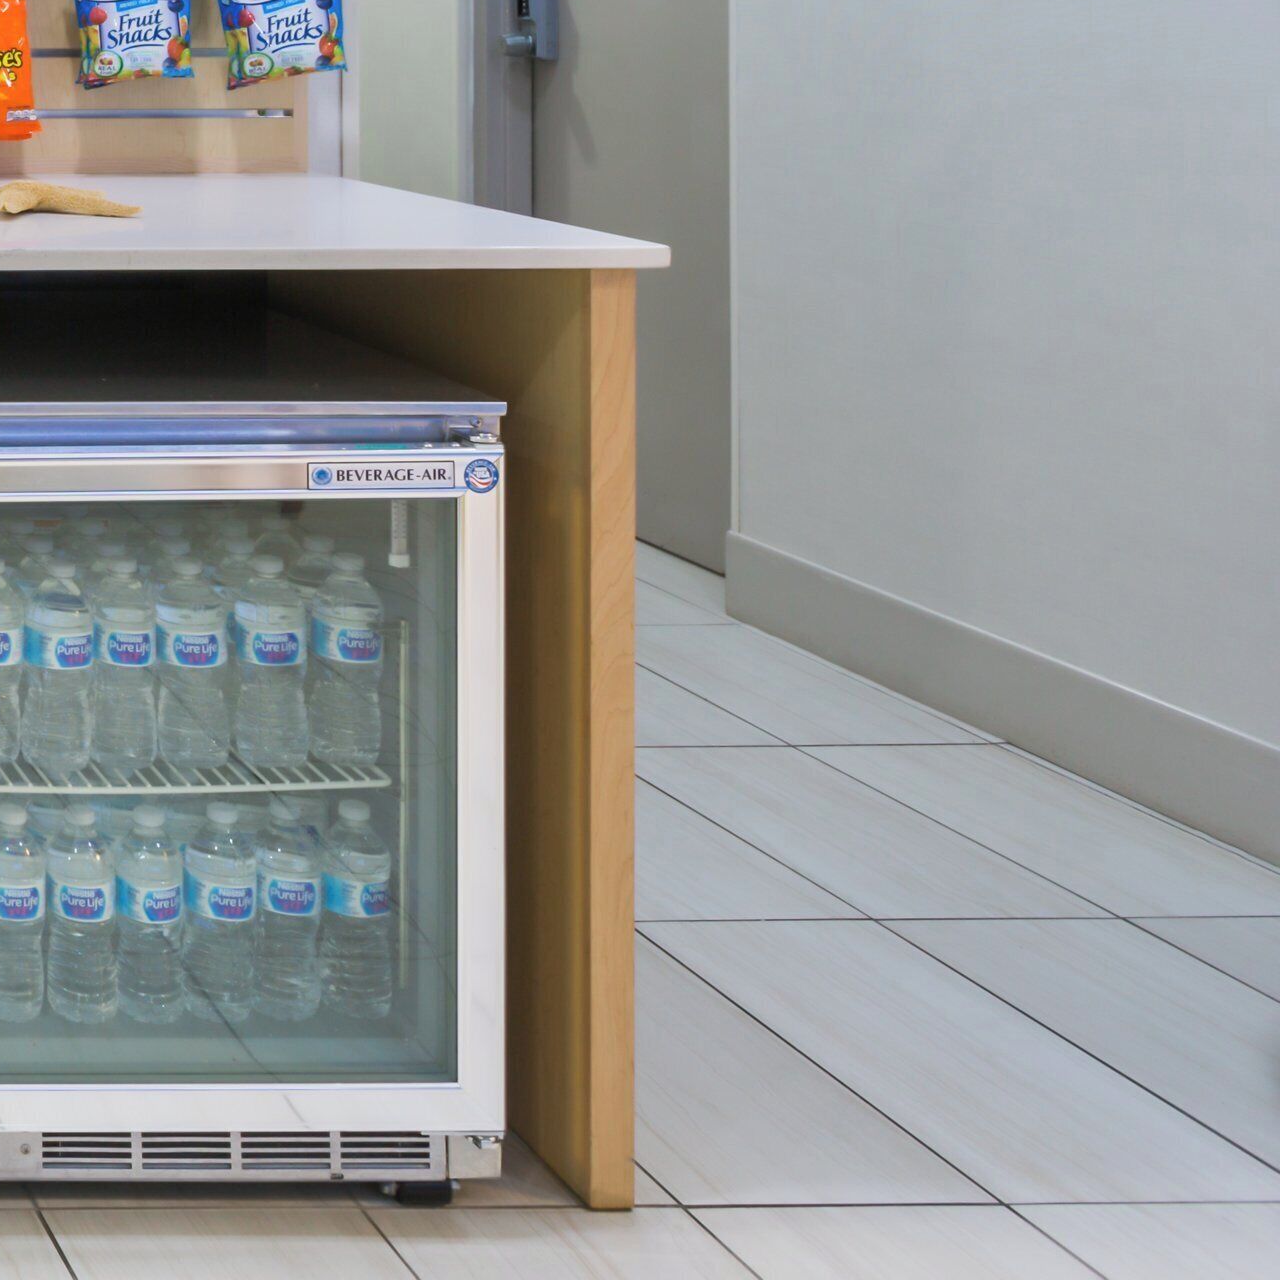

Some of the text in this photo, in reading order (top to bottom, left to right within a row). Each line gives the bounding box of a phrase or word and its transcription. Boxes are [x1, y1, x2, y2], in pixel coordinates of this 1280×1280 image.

[119, 6, 163, 31] Fruit
[267, 7, 312, 32] Fruit
[107, 23, 172, 49] Snacks
[256, 24, 323, 51] Snacks
[336, 468, 447, 482] BEVERAGE-AIR
